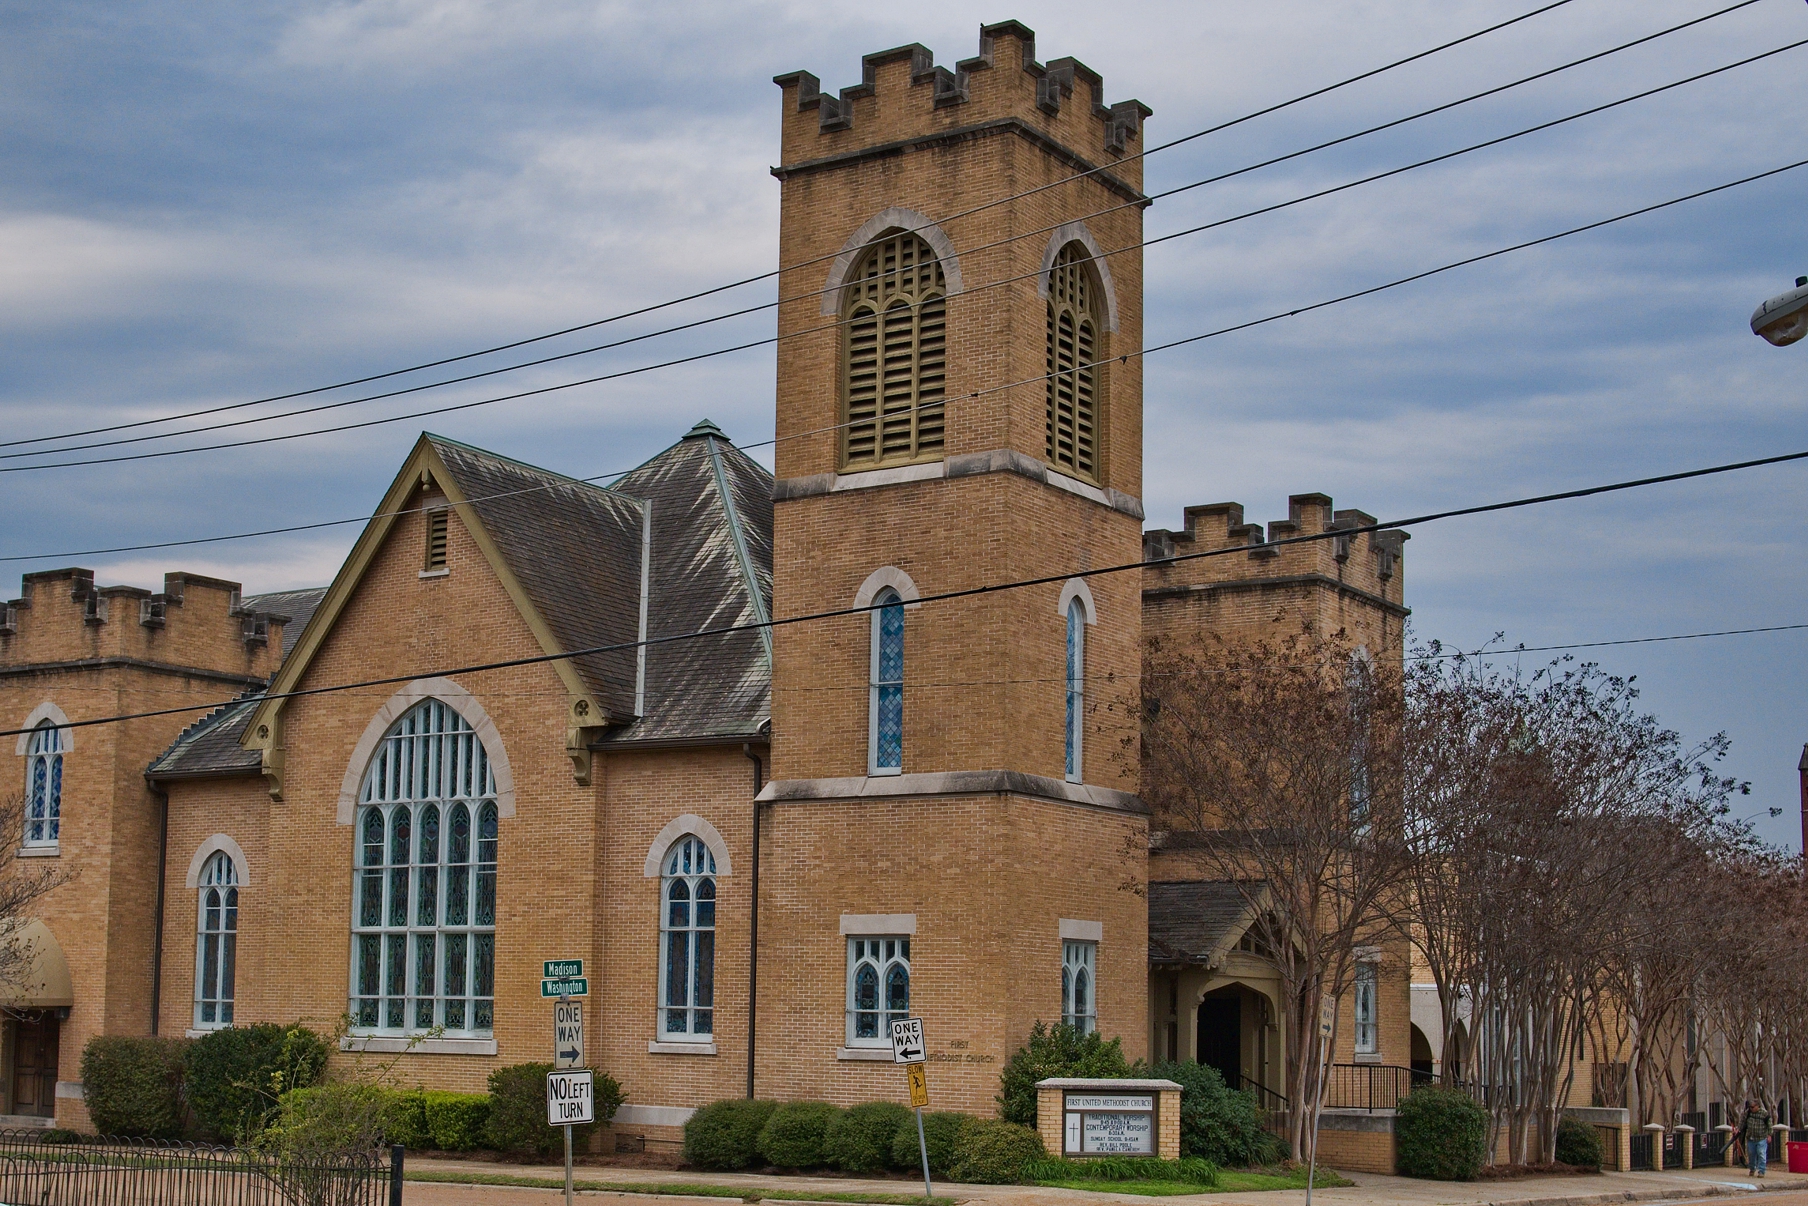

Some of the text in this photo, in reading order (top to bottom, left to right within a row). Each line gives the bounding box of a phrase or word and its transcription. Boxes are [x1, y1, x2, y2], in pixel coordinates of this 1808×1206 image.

[548, 962, 578, 976] Madison
[546, 980, 583, 995] Washington
[558, 1007, 580, 1023] ONE
[558, 1026, 581, 1042] WAY
[894, 1021, 919, 1035] ONE
[895, 1034, 920, 1047] WAY
[950, 1040, 969, 1049] FIRST
[927, 1053, 995, 1063] ETHODIST CHURCH
[908, 1064, 923, 1075] SLOW
[550, 1077, 590, 1101] NO LEFT
[558, 1101, 583, 1119] TURN
[1082, 1099, 1101, 1107] UNITED
[1103, 1099, 1129, 1107] METHODIST
[1131, 1099, 1151, 1107] CHURCH
